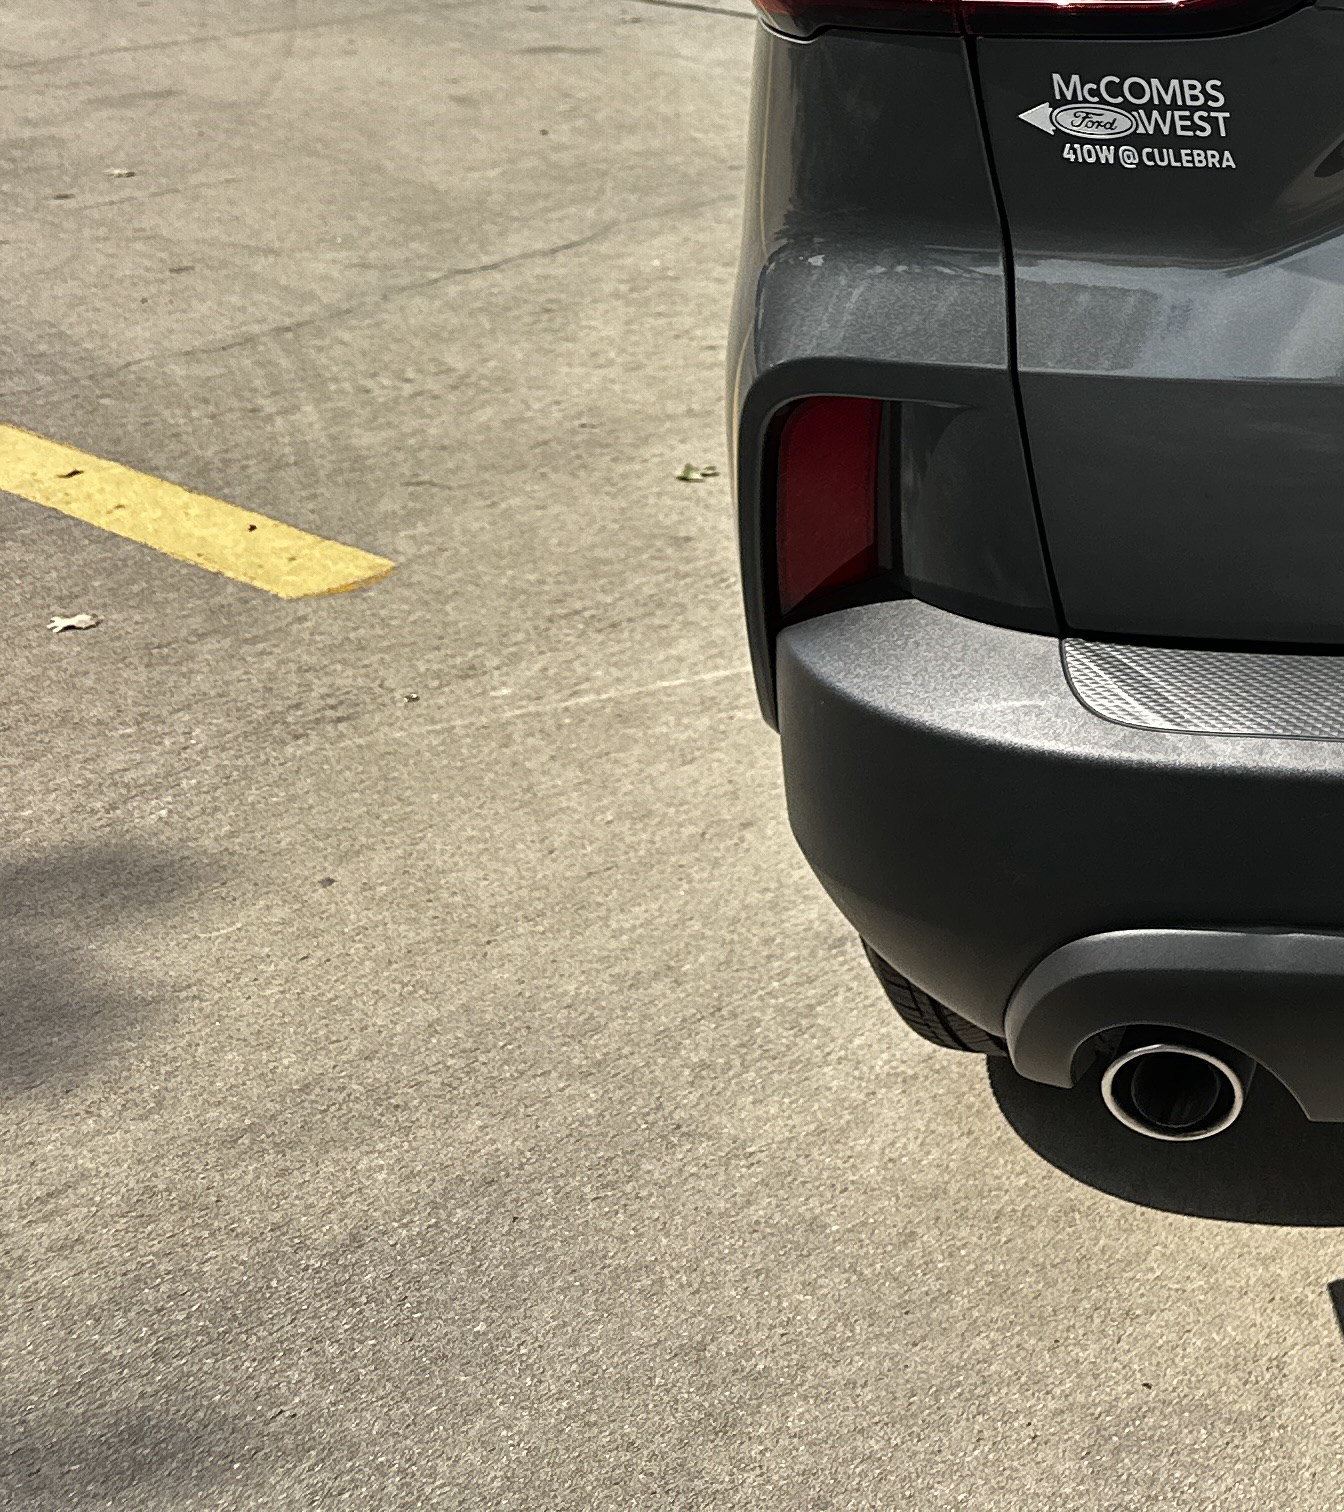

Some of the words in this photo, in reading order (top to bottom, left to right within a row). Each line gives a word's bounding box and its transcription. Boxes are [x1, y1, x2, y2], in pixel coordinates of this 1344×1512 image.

[1051, 72, 1226, 108] McCOMBS
[1070, 110, 1118, 132] Ford
[1139, 109, 1231, 137] WEST
